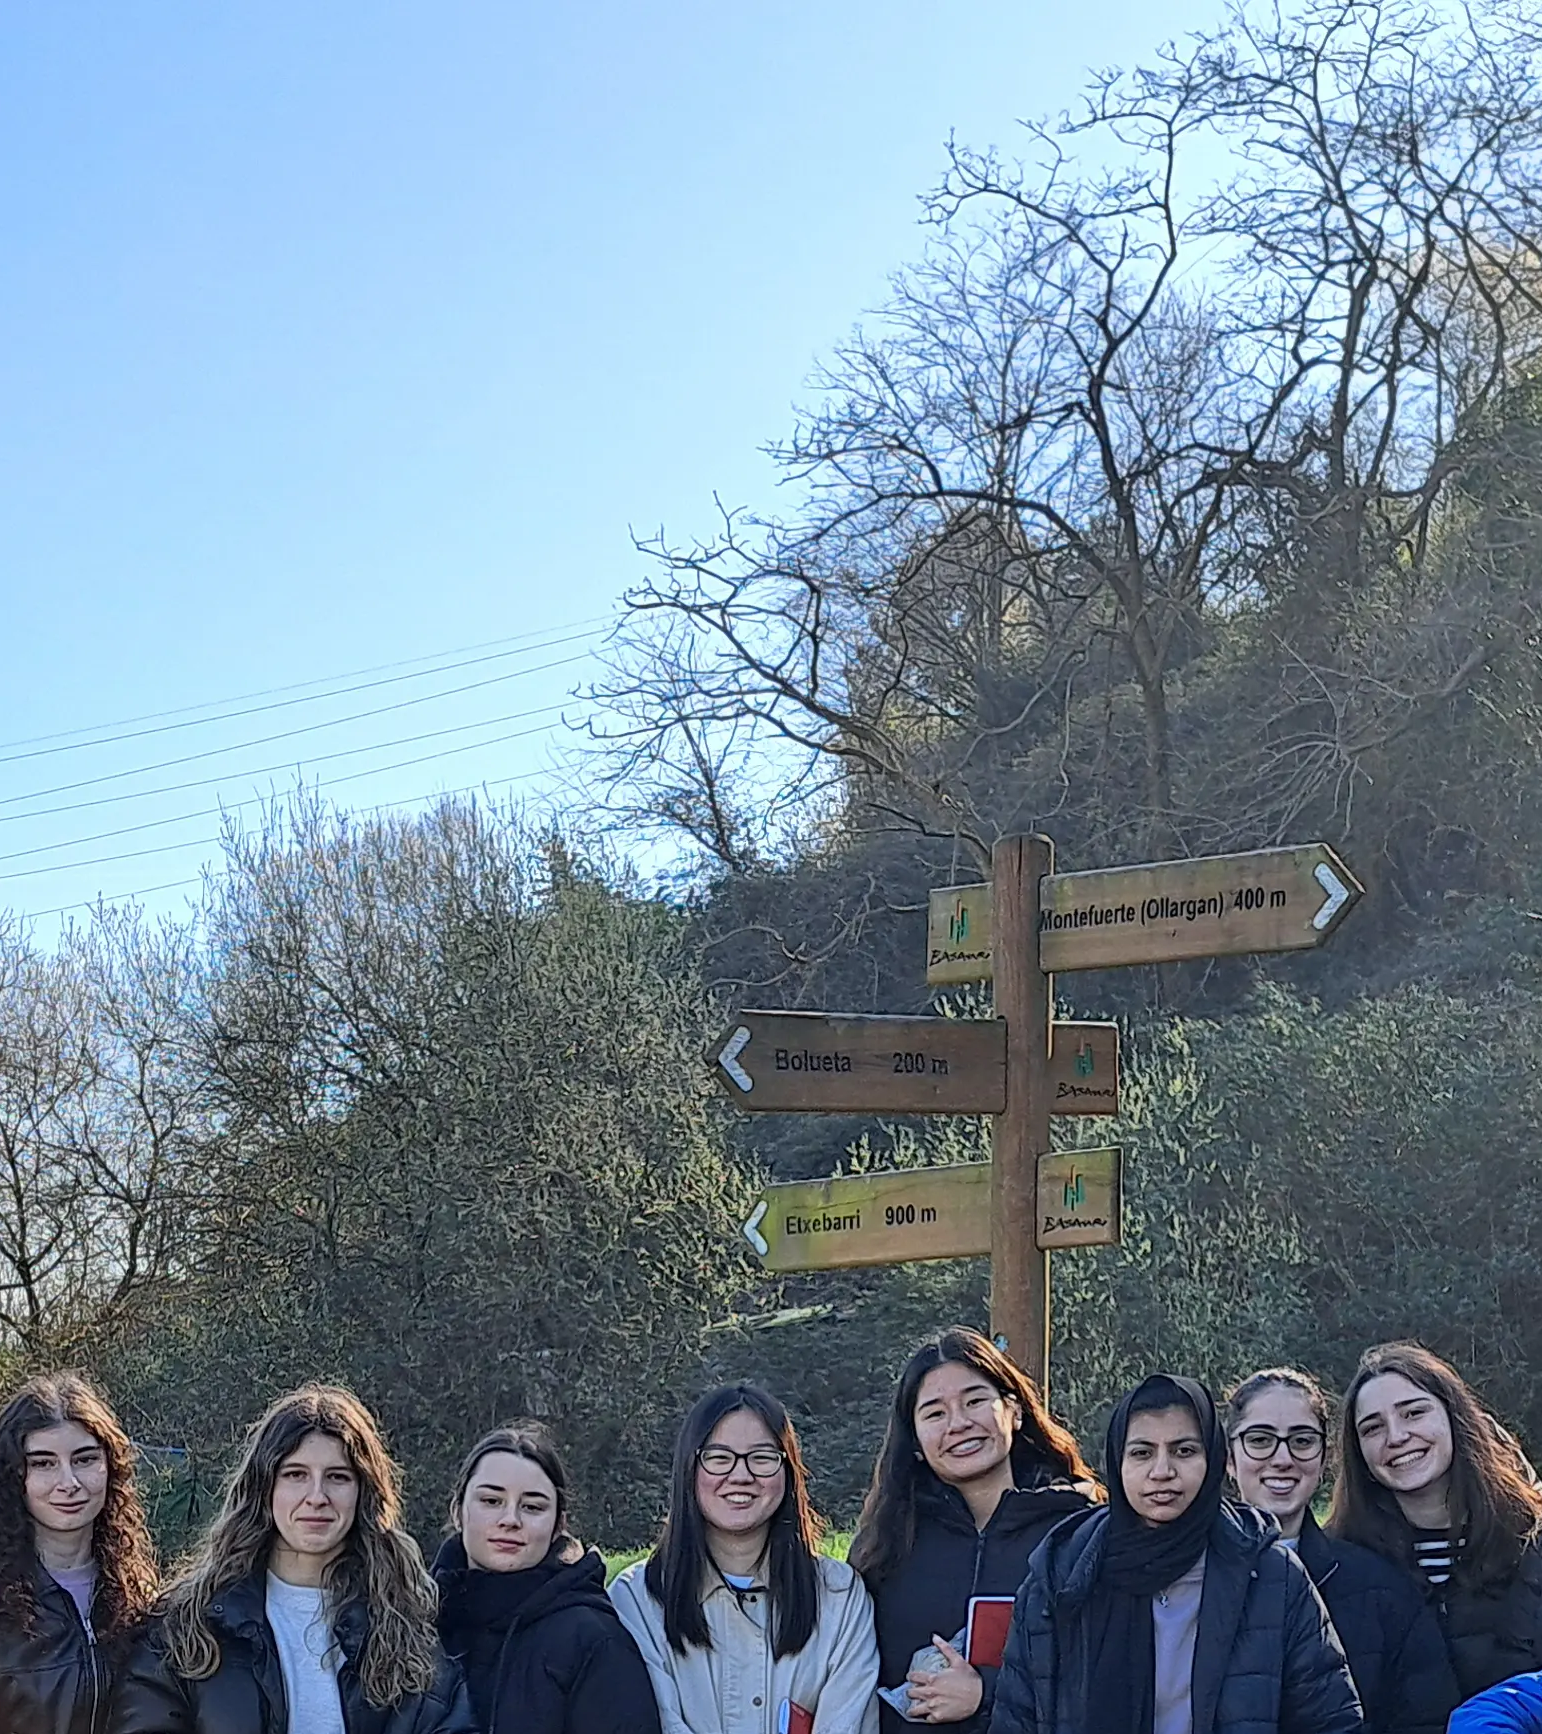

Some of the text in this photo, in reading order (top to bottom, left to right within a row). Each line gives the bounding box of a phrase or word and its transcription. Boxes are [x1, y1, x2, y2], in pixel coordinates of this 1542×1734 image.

[1040, 886, 1287, 931] Montefuerte (Ollargan) 400 m
[775, 1049, 949, 1075] Bolueta 200 m
[785, 1203, 937, 1235] Etxebarri 900 m
